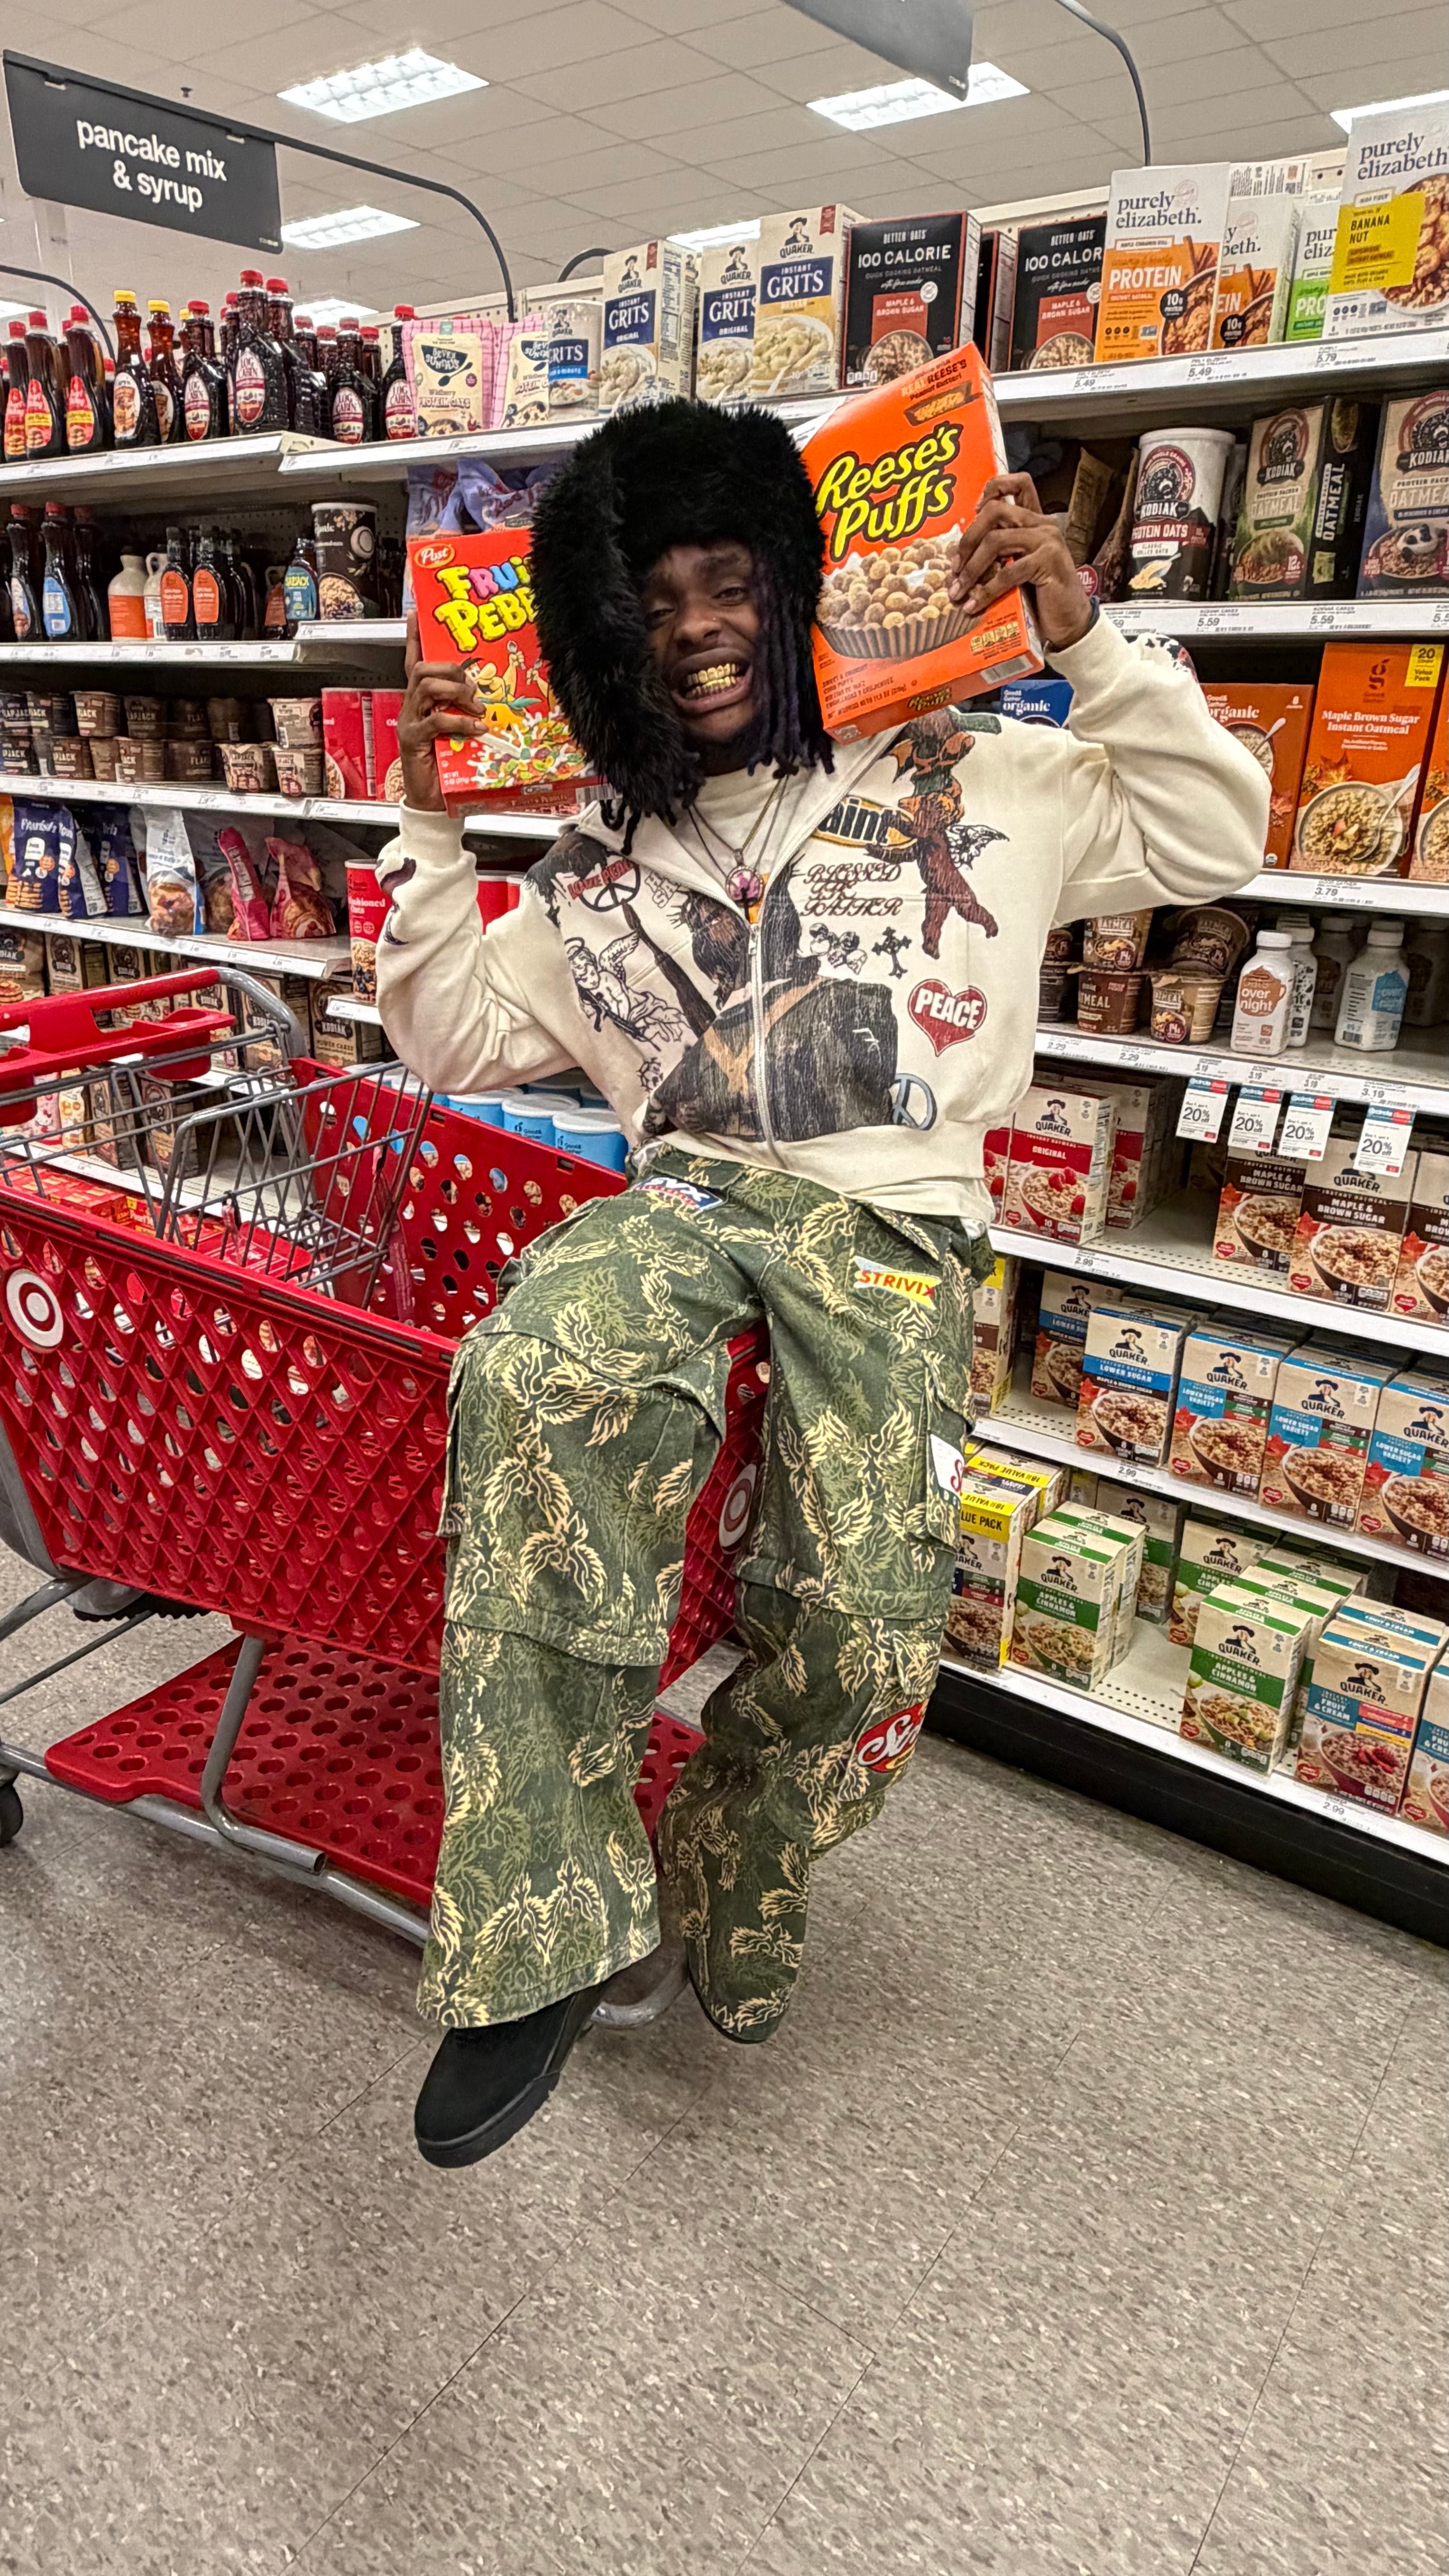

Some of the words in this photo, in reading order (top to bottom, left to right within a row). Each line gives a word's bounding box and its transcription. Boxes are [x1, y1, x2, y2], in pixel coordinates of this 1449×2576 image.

[77, 120, 180, 168] pancake
[186, 150, 227, 181] mix
[1359, 133, 1425, 165] purely
[113, 160, 132, 191] &
[138, 174, 202, 212] syrup
[1118, 191, 1176, 215] purely
[1116, 207, 1202, 229] elizabeth.
[1351, 214, 1389, 230] BANANA
[1350, 231, 1369, 244] NUT
[780, 243, 814, 259] QUAKER
[858, 252, 881, 268] 100
[884, 244, 952, 265] CALORIE
[1025, 256, 1048, 271] 100
[1051, 246, 1102, 267] CALOR
[781, 263, 811, 275] INSTANT
[913, 265, 942, 274] OATMEAL
[618, 278, 642, 293] QUAKER
[721, 271, 752, 285] QUAKER
[767, 270, 823, 299] GRITS
[1109, 266, 1182, 290] PROTEIN
[618, 297, 640, 307] INSTANT
[722, 290, 750, 300] INSTANT
[709, 296, 756, 323] GRITS
[876, 306, 900, 316] BROWN
[902, 304, 925, 314] SUGAR
[886, 299, 907, 307] MAPLE
[1052, 300, 1074, 310] MAPLE
[609, 303, 649, 331] GRITS
[1042, 309, 1066, 319] BROWN
[1068, 306, 1090, 316] SUGAR
[616, 332, 639, 342] ORIGINAL
[719, 325, 748, 336] ORIGINAL
[1316, 353, 1336, 363] 5.79
[901, 378, 925, 397] REAL
[927, 359, 967, 383] REESE'S
[1188, 367, 1211, 377] 5.49
[1074, 379, 1095, 388] 5.49
[815, 421, 964, 518] Reese's
[1265, 462, 1296, 482] KODIAK
[1251, 496, 1300, 518] OATMEAL
[1322, 464, 1345, 541] OATMEAL
[833, 469, 953, 558] Puffs
[1141, 502, 1178, 519] KODIAK
[1163, 524, 1188, 537] OATS
[420, 547, 450, 565] Post
[1197, 617, 1220, 626] 5.59
[1310, 615, 1334, 625] 5.59
[1418, 648, 1435, 659] 20
[1292, 696, 1299, 704] 8
[1003, 701, 1051, 715] organic
[1206, 704, 1260, 721] organic
[1322, 710, 1352, 722] Maple
[1354, 711, 1388, 723] Brown
[1389, 713, 1420, 724] Sugar
[1327, 722, 1363, 732] Instant
[1365, 723, 1409, 735] Oatmeal
[1315, 887, 1338, 897] 3.79
[1241, 988, 1270, 998] over
[913, 988, 983, 1030] PEACE
[1240, 999, 1273, 1013] night
[1047, 1042, 1066, 1051] 2.29
[1119, 1052, 1139, 1061] 2.29
[1248, 1071, 1262, 1080] 3.19
[1361, 1088, 1385, 1099] 3.19
[1182, 1107, 1202, 1122] 20
[1202, 1110, 1210, 1118] %
[1035, 1121, 1072, 1137] QUAKER
[1234, 1117, 1255, 1132] 20
[1285, 1125, 1306, 1140] 20
[1032, 1146, 1067, 1159] ORIGINAL
[1361, 1140, 1383, 1154] 20
[1383, 1142, 1392, 1150] %
[1253, 1169, 1284, 1182] MAPLE
[1285, 1174, 1292, 1182] &
[1240, 1176, 1272, 1188] BROWN
[1274, 1180, 1303, 1193] SUGAR
[1334, 1176, 1381, 1194] QUAKER
[1322, 1190, 1353, 1199] INSTANT
[1331, 1198, 1365, 1212] MAPLE
[1366, 1203, 1373, 1213] &
[1317, 1205, 1352, 1218] BROWN
[1353, 1210, 1385, 1224] SUGAR
[1044, 1219, 1052, 1227] 10
[1075, 1257, 1093, 1266] 2.99
[857, 1269, 936, 1298] STRIVIX
[1340, 1283, 1348, 1292] 8
[1109, 1348, 1149, 1366] QUAKER
[1099, 1364, 1125, 1377] LOWER
[1127, 1371, 1152, 1383] SUGAR
[1206, 1372, 1249, 1392] QUAKER
[1182, 1388, 1202, 1398] LOWER
[1203, 1393, 1224, 1403] SUGAR
[1189, 1397, 1215, 1408] VARIETY
[1301, 1400, 1346, 1421] QUAKER
[1275, 1415, 1296, 1426] LOWER
[1297, 1421, 1319, 1433] SUGAR
[1281, 1424, 1309, 1436] VARIETY
[1403, 1426, 1449, 1448] QUAKER
[1375, 1441, 1398, 1453] LOWER
[1399, 1448, 1421, 1461] SUGAR
[1383, 1451, 1412, 1464] VARIETY
[1118, 1466, 1136, 1477] 2.99
[979, 1516, 1003, 1532] PACK
[1411, 1533, 1418, 1542] 8
[1204, 1555, 1242, 1573] QUAKER
[1041, 1573, 1079, 1594] QUAKER
[1039, 1592, 1068, 1606] APPLES
[1036, 1598, 1076, 1617] CINNAMON
[1218, 1642, 1262, 1668] QUAKER
[1211, 1669, 1257, 1692] CINNAMON
[1215, 1663, 1248, 1682] APPLES
[1249, 1674, 1256, 1684] &
[1340, 1681, 1388, 1707] QUAKER
[1321, 1698, 1346, 1711] FRUIT
[1321, 1706, 1350, 1721] CREAM
[1323, 1802, 1345, 1816] 2.99
